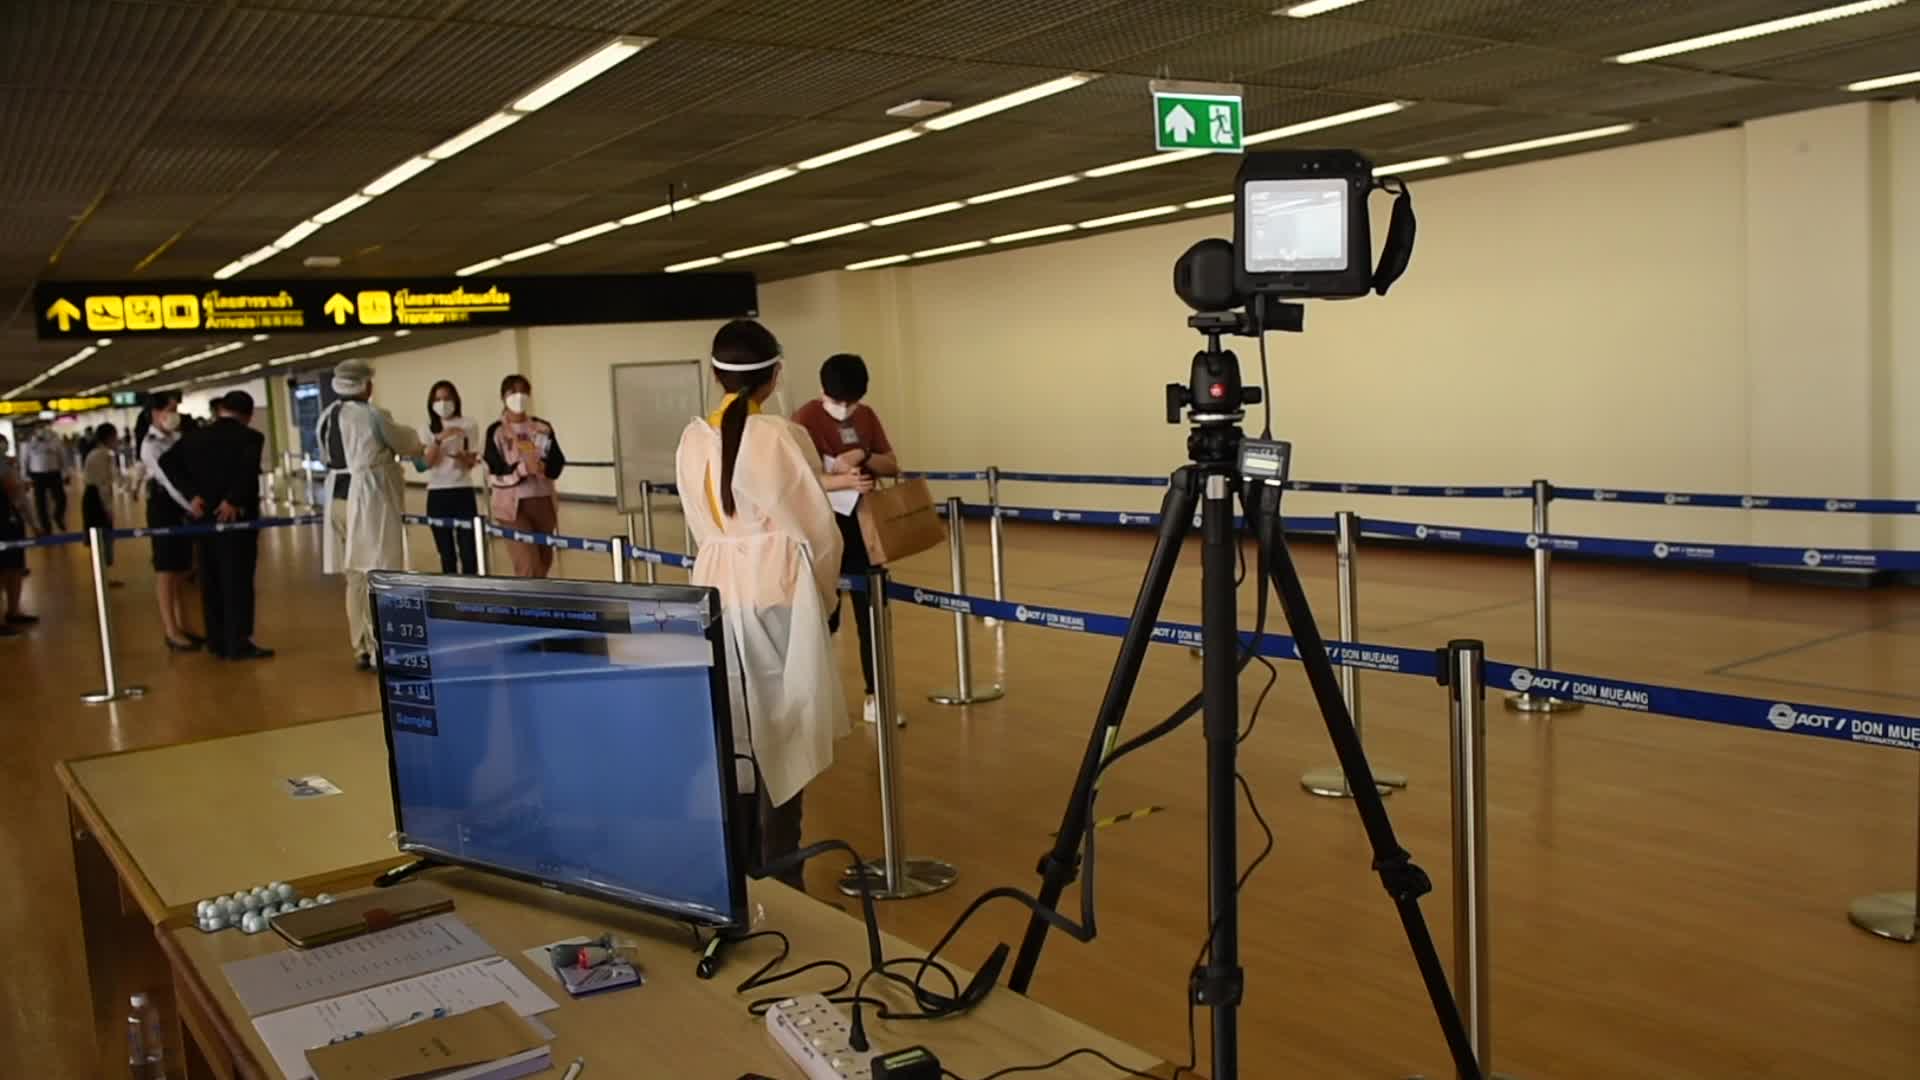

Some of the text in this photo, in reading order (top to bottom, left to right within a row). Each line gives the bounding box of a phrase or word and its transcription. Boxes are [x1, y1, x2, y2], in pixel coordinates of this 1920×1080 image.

[400, 623, 425, 639] 37.3
[402, 654, 428, 669] 29.5
[1362, 651, 1399, 666] MUEANG
[1532, 677, 1560, 690] AOT
[1572, 682, 1597, 697] DON
[1600, 686, 1649, 704] MUEANG
[1796, 713, 1834, 728] AOT
[1851, 719, 1883, 736] DON
